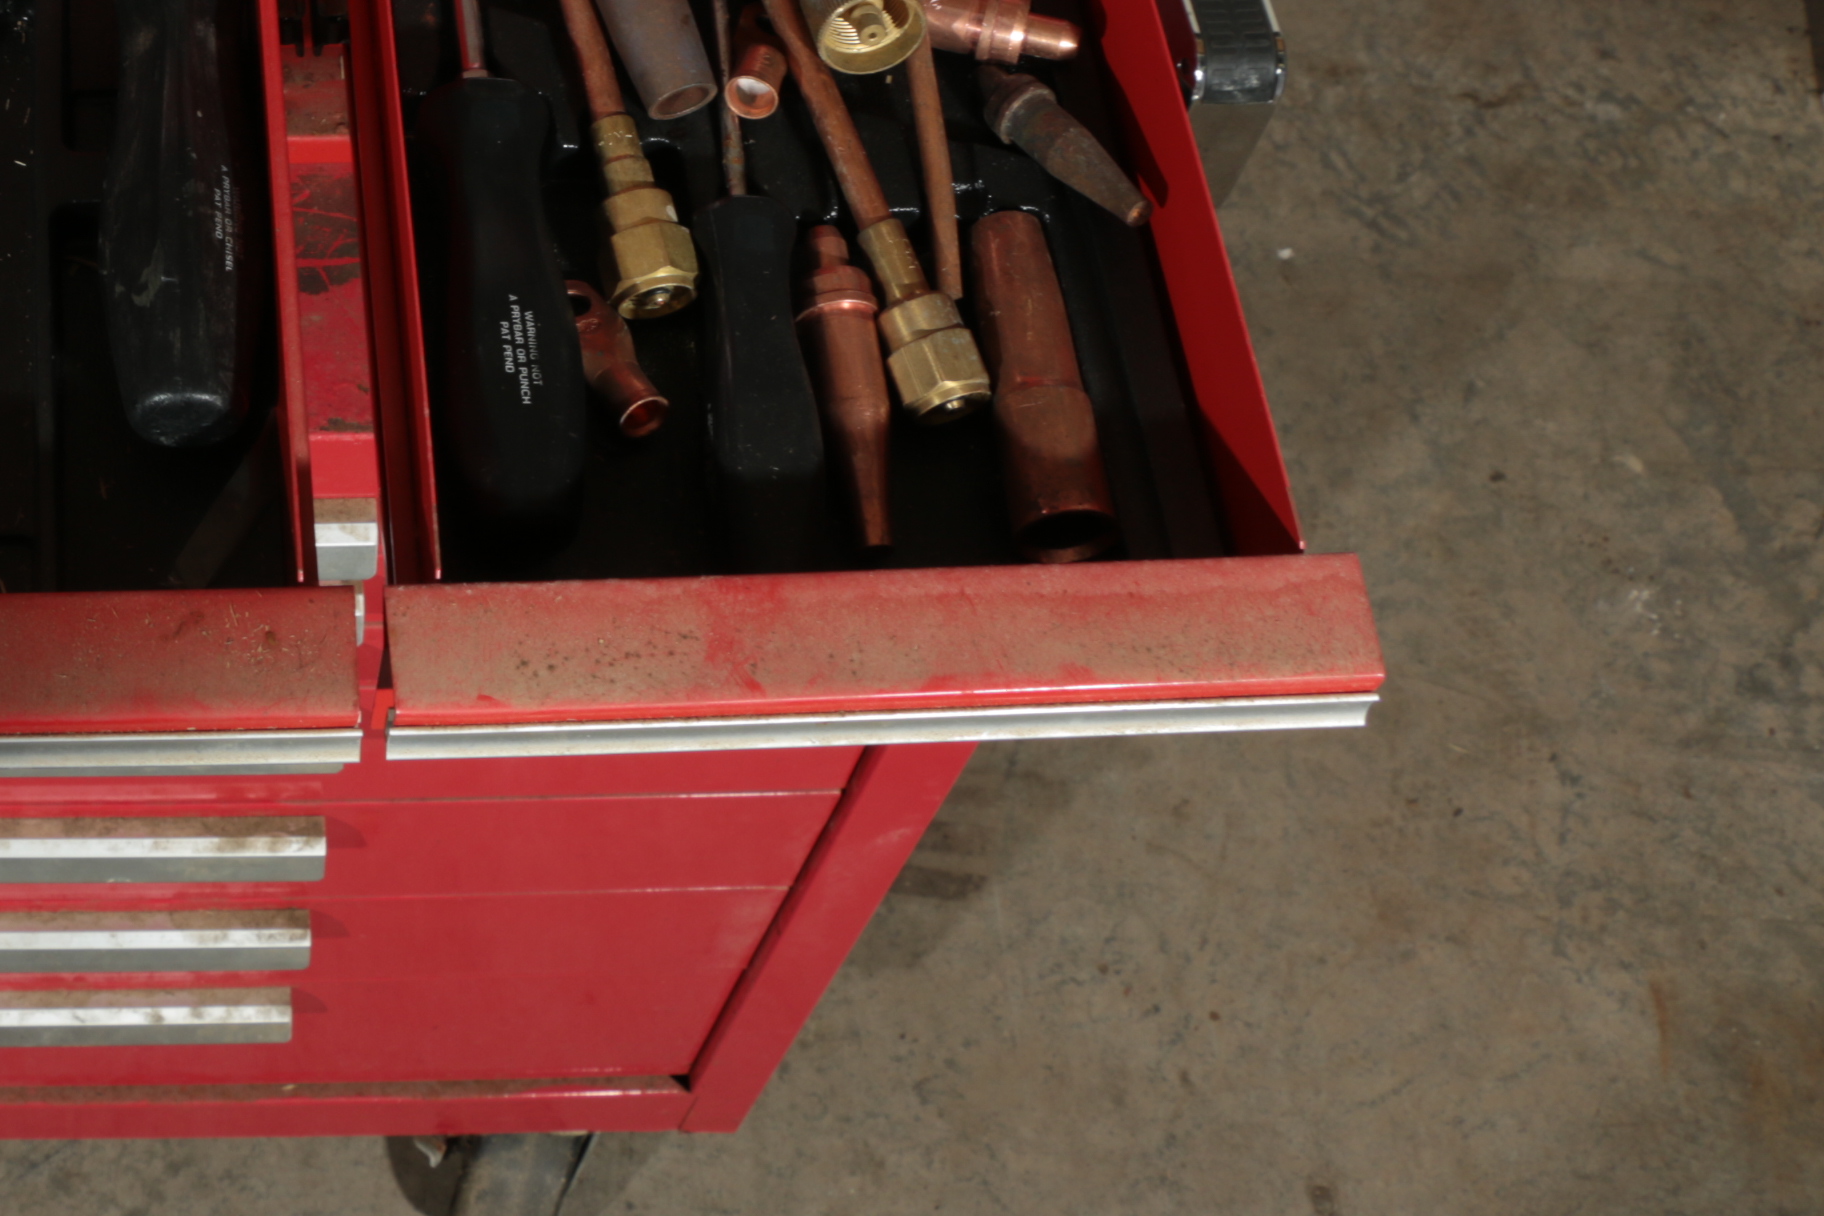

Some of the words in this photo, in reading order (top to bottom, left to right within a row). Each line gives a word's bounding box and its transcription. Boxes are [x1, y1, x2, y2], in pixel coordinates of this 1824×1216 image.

[214, 188, 222, 208] PAT
[222, 175, 232, 214] PRYBAR
[224, 218, 233, 232] OR
[224, 236, 234, 272] CHISEL
[508, 294, 519, 302] A
[499, 321, 511, 341] PAT
[509, 304, 525, 344] PRYBAR
[502, 344, 516, 373] PEND
[515, 348, 527, 363] OR
[524, 311, 538, 360] WARNING
[531, 364, 543, 386] NOT
[518, 367, 532, 405] PUNCH
